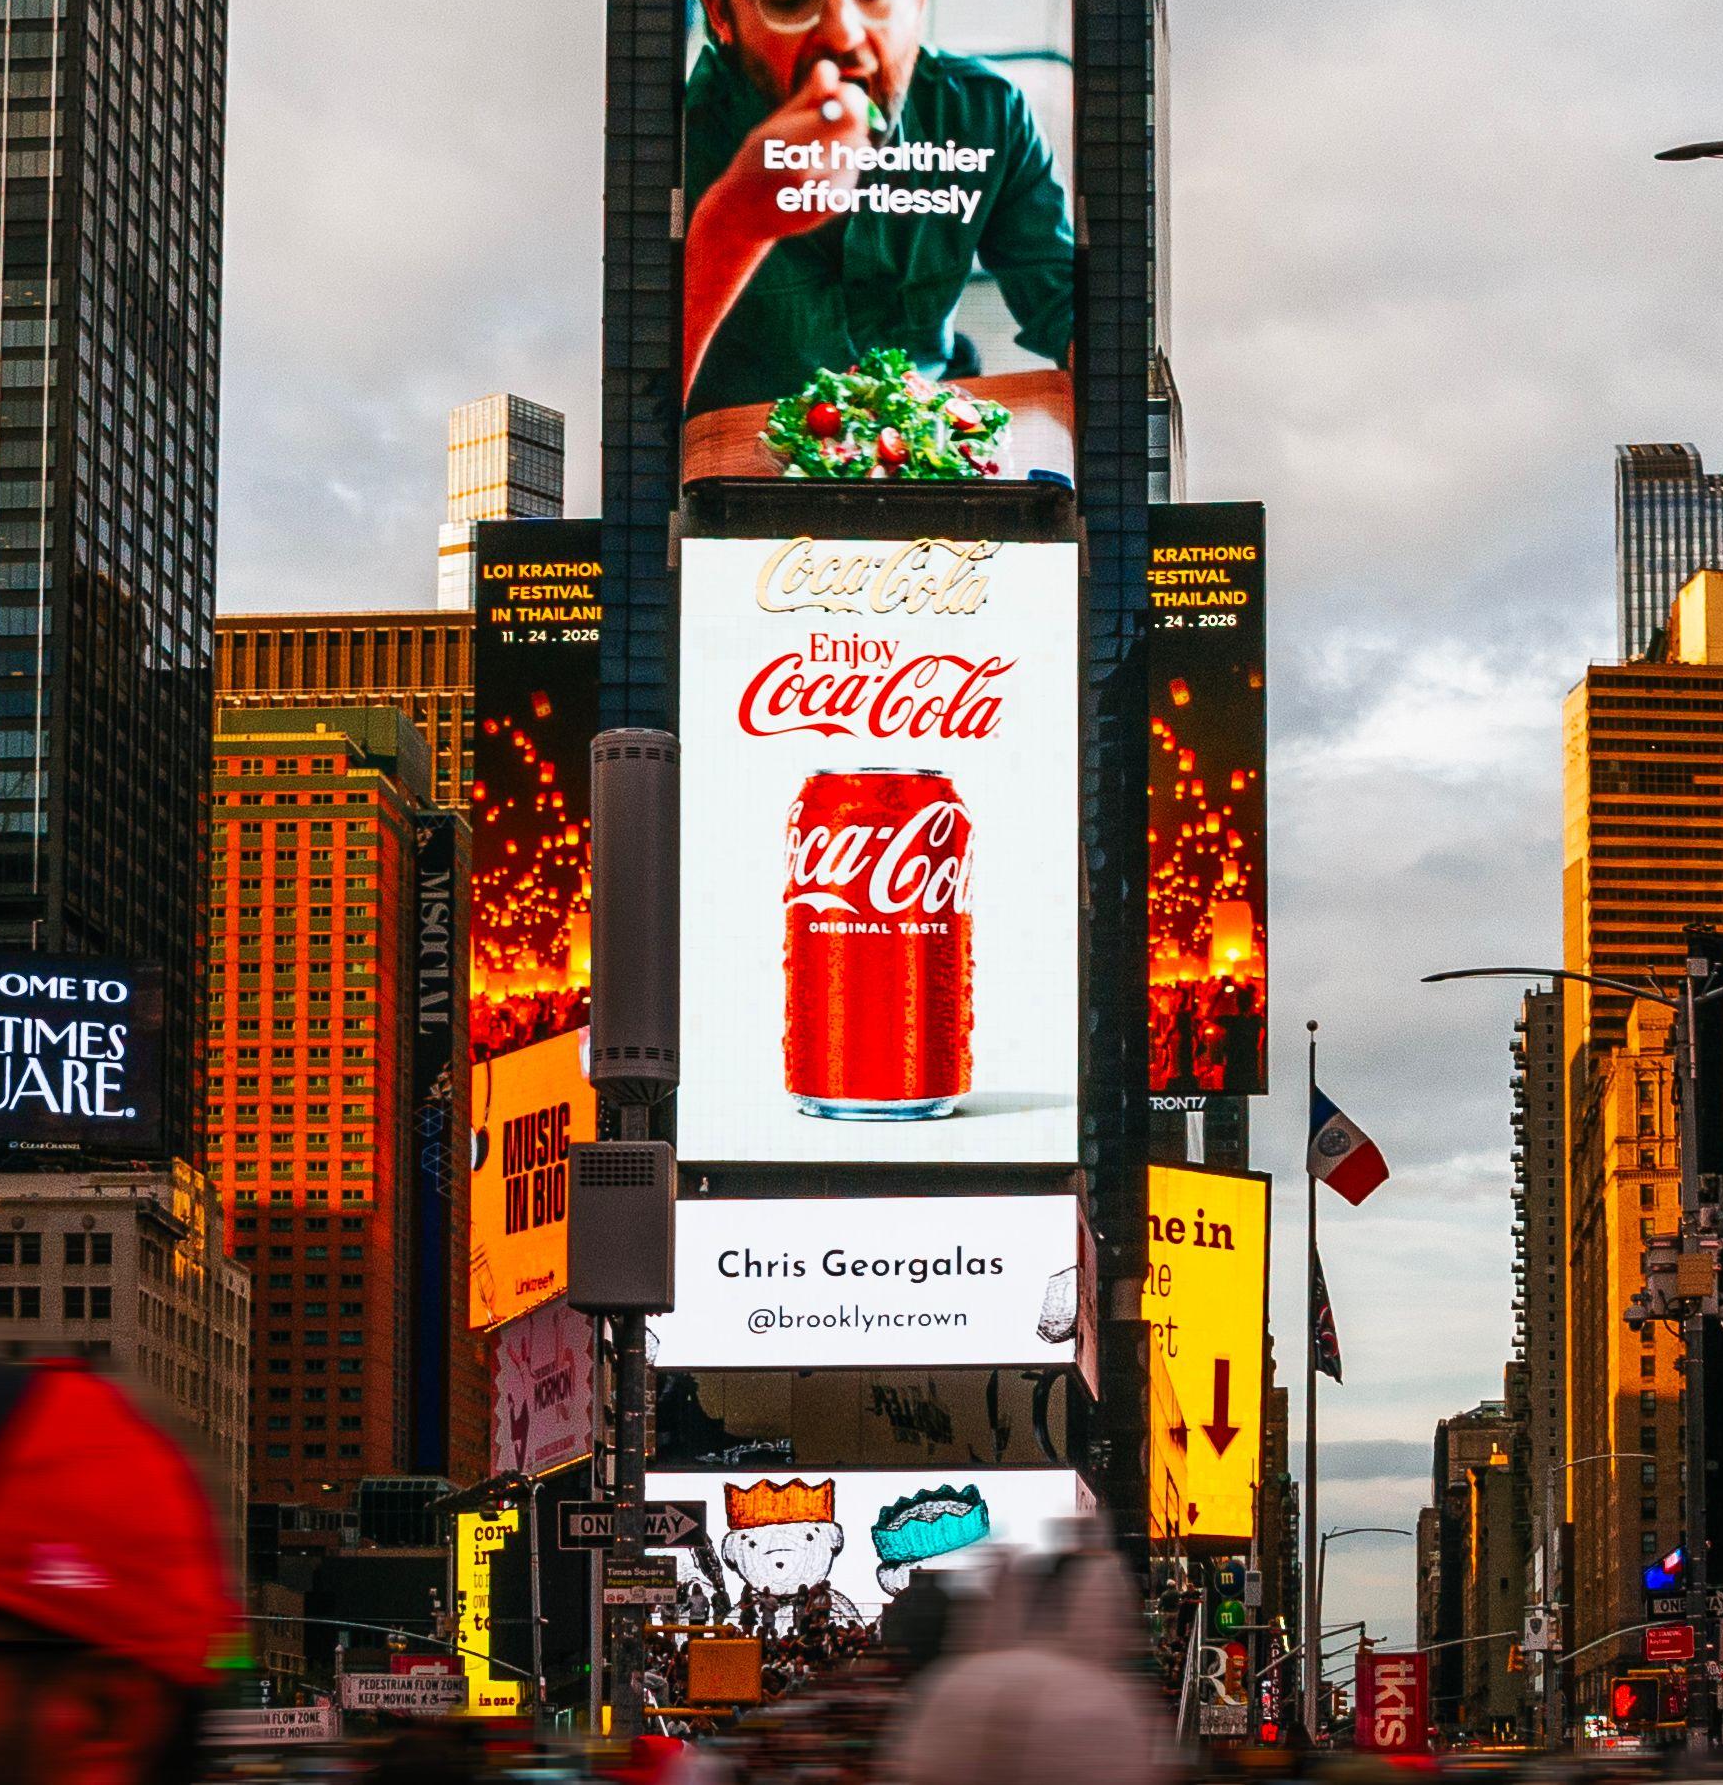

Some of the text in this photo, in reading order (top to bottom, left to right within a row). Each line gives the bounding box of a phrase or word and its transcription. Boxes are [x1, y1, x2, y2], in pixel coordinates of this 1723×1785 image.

[764, 140, 995, 173] Eat healthier
[776, 182, 981, 224] effortlessly
[1153, 546, 1256, 562] KRATHONG
[483, 563, 603, 580] LOI KRATHON
[755, 537, 1002, 616] Coca-Cola
[508, 585, 594, 600] FESTIVAL
[1151, 591, 1247, 607] THAILAND
[491, 608, 512, 622] IN
[1164, 614, 1237, 628] 24 2026
[502, 629, 600, 643] 11 24 2026
[809, 632, 899, 669] Enjoy
[738, 653, 1020, 739] Coca-Cola
[809, 922, 948, 934] ORIGINAL TASTE
[83, 979, 128, 1003] TO
[502, 1101, 571, 1178] MUSIC
[506, 1162, 566, 1236] IN BIO
[1193, 1209, 1235, 1251] in
[717, 1245, 1005, 1284] Chris Georgalas
[515, 1276, 551, 1298] Linktree
[747, 1304, 968, 1335] @brooklyncrown
[607, 1567, 665, 1578] Times Square
[1221, 1570, 1234, 1585] m
[1220, 1611, 1233, 1625] m
[359, 1678, 464, 1691] PEDESTRIAN FLOW ZONE
[358, 1693, 417, 1705] KEEP MOVING
[479, 1693, 516, 1707] in one
[1374, 1659, 1419, 1747] tkts
[273, 1712, 321, 1725] FLOW ZONE
